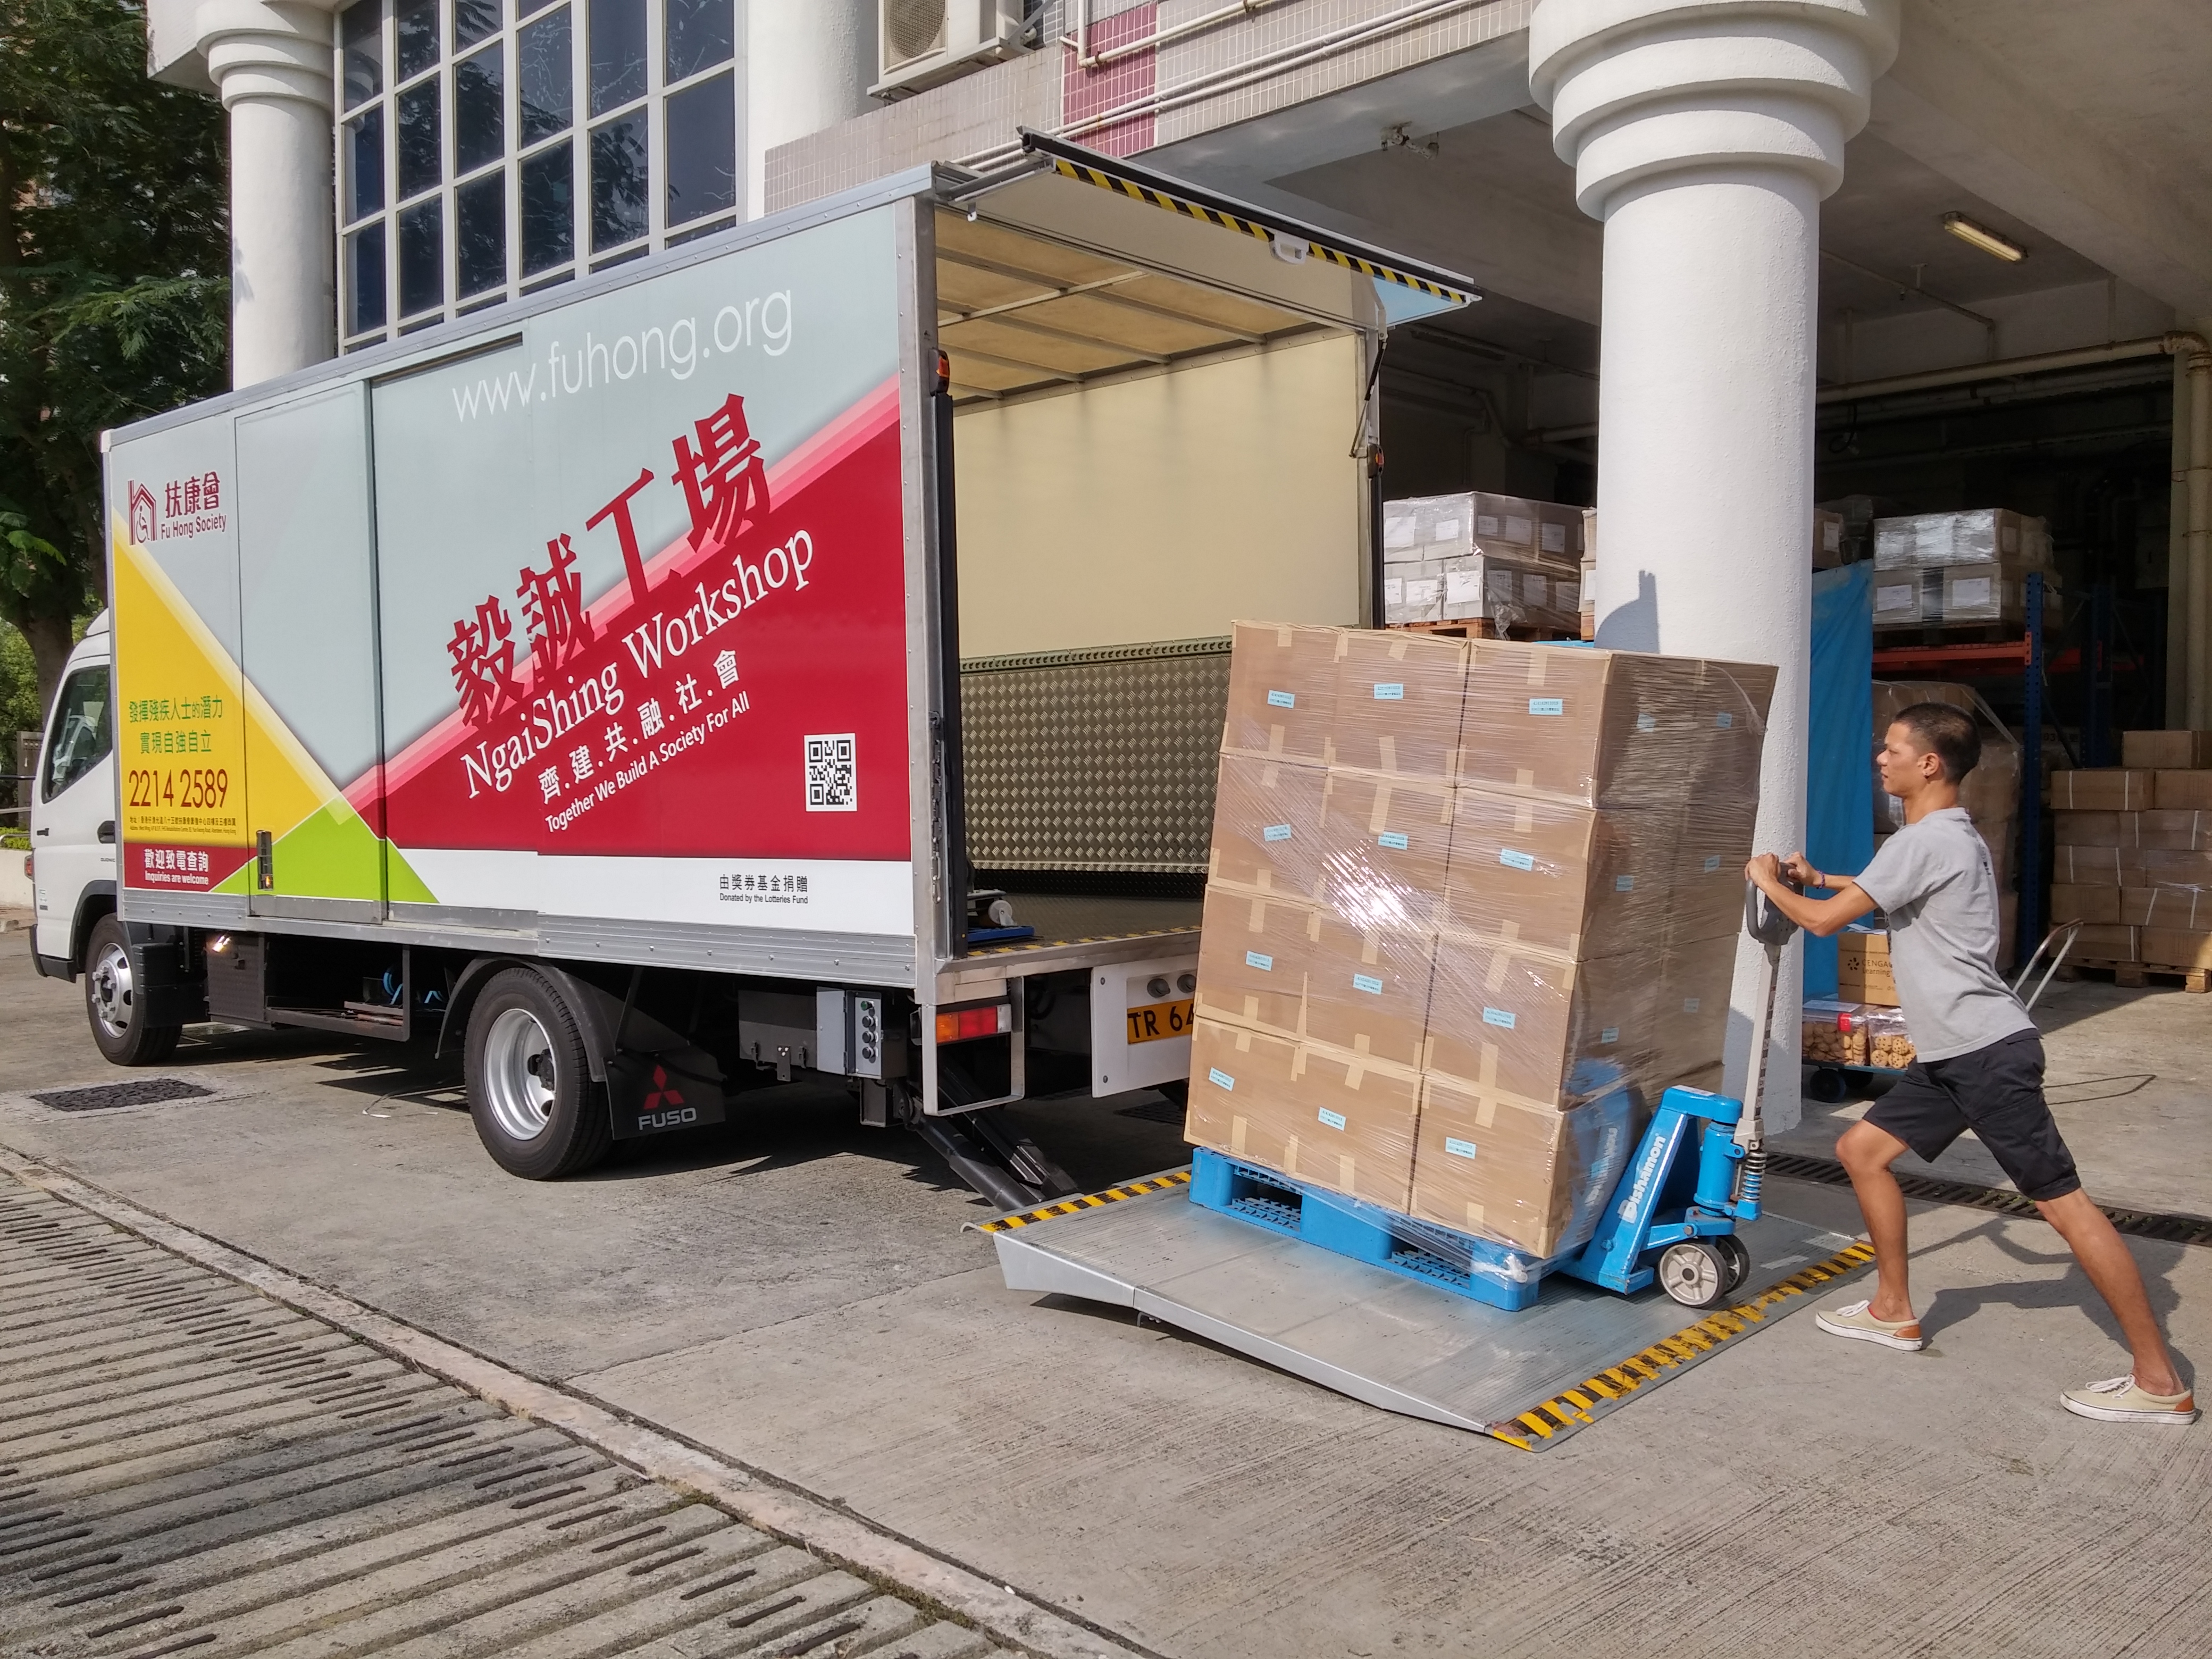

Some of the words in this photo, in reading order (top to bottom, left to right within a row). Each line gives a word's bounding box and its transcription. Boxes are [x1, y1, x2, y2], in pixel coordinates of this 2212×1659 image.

[452, 289, 792, 423] www.fuhong.org
[165, 471, 220, 518] 扶康會
[161, 524, 170, 540] Fu
[173, 521, 193, 538] Hong
[196, 513, 227, 533] Society
[447, 392, 771, 727] 毅誠工場
[460, 661, 624, 799] NgaiShing
[621, 529, 814, 678] Workshop
[140, 730, 212, 754] 實現自強自立
[545, 792, 594, 833] Together
[594, 780, 616, 801] We
[616, 755, 648, 790] Build
[649, 750, 660, 770] A
[659, 723, 705, 762] Society
[706, 708, 729, 733] For
[732, 691, 750, 718] All
[129, 769, 174, 807] 2214
[180, 769, 228, 808] 2589
[144, 848, 209, 872] 歡迎致電查詢
[145, 870, 171, 884] Inquiries
[171, 874, 181, 883] are
[182, 873, 209, 885] welcome
[745, 894, 752, 903] by
[765, 894, 791, 903] Lotteries
[792, 895, 808, 904] Fund
[1127, 1010, 1160, 1038] TR
[638, 1107, 697, 1131] FUSO
[1617, 1135, 1666, 1224] Bishamon
